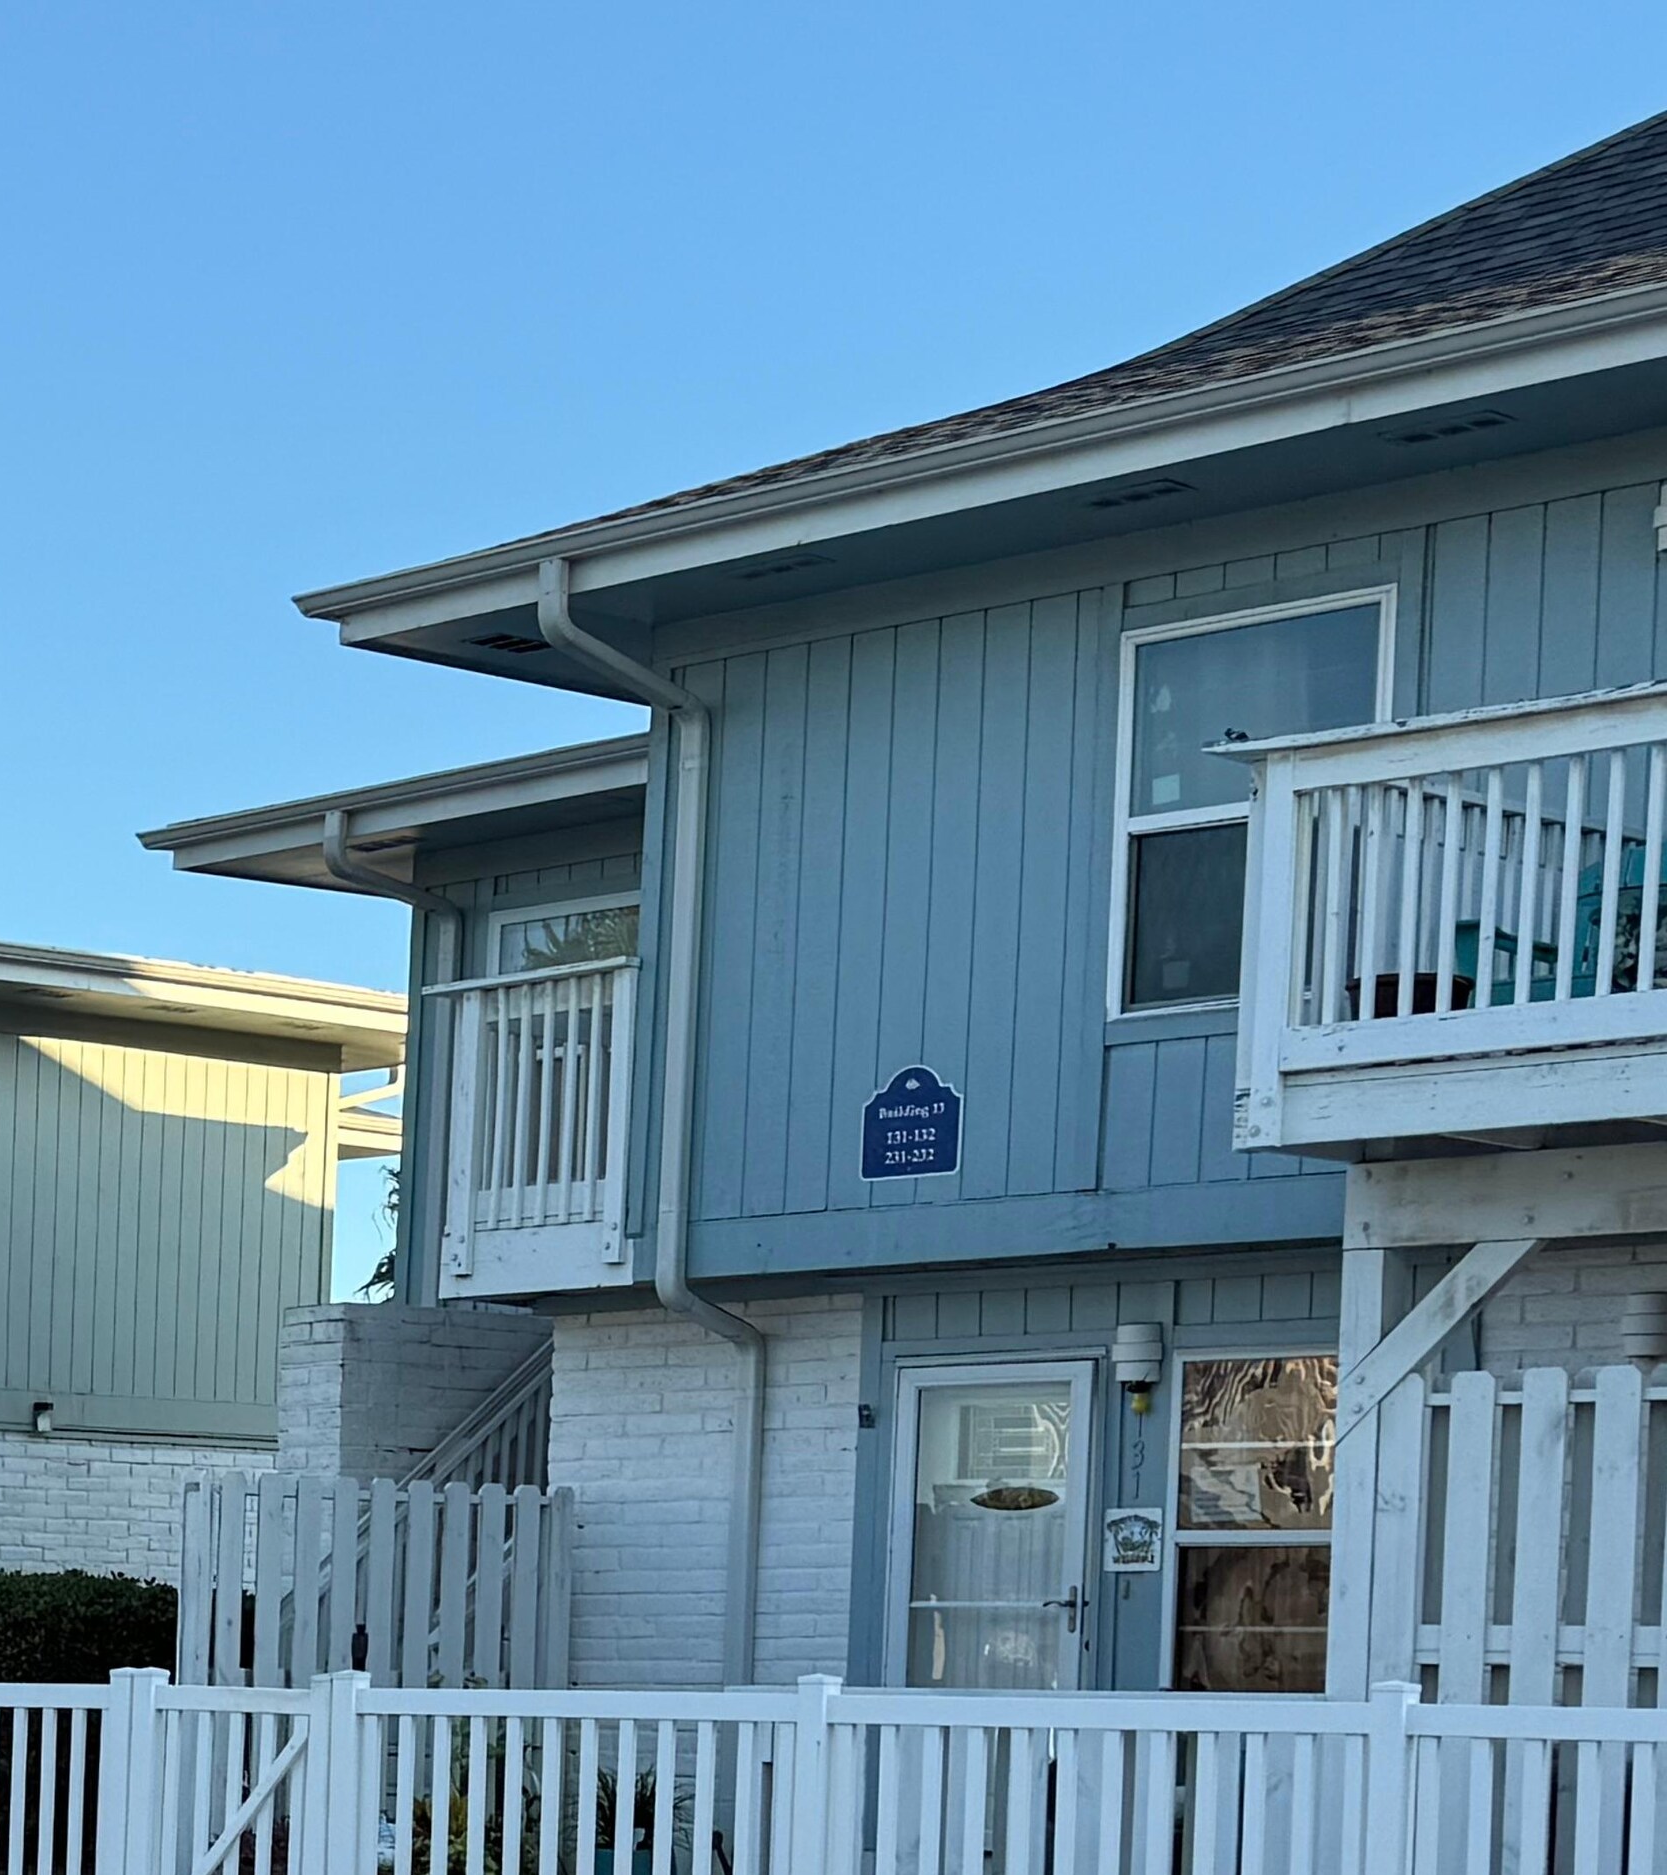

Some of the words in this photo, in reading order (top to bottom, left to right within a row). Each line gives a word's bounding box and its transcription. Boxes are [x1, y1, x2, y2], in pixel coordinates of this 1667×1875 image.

[879, 1104, 929, 1119] Building
[886, 1128, 937, 1145] 131-132
[884, 1149, 935, 1165] 231-232
